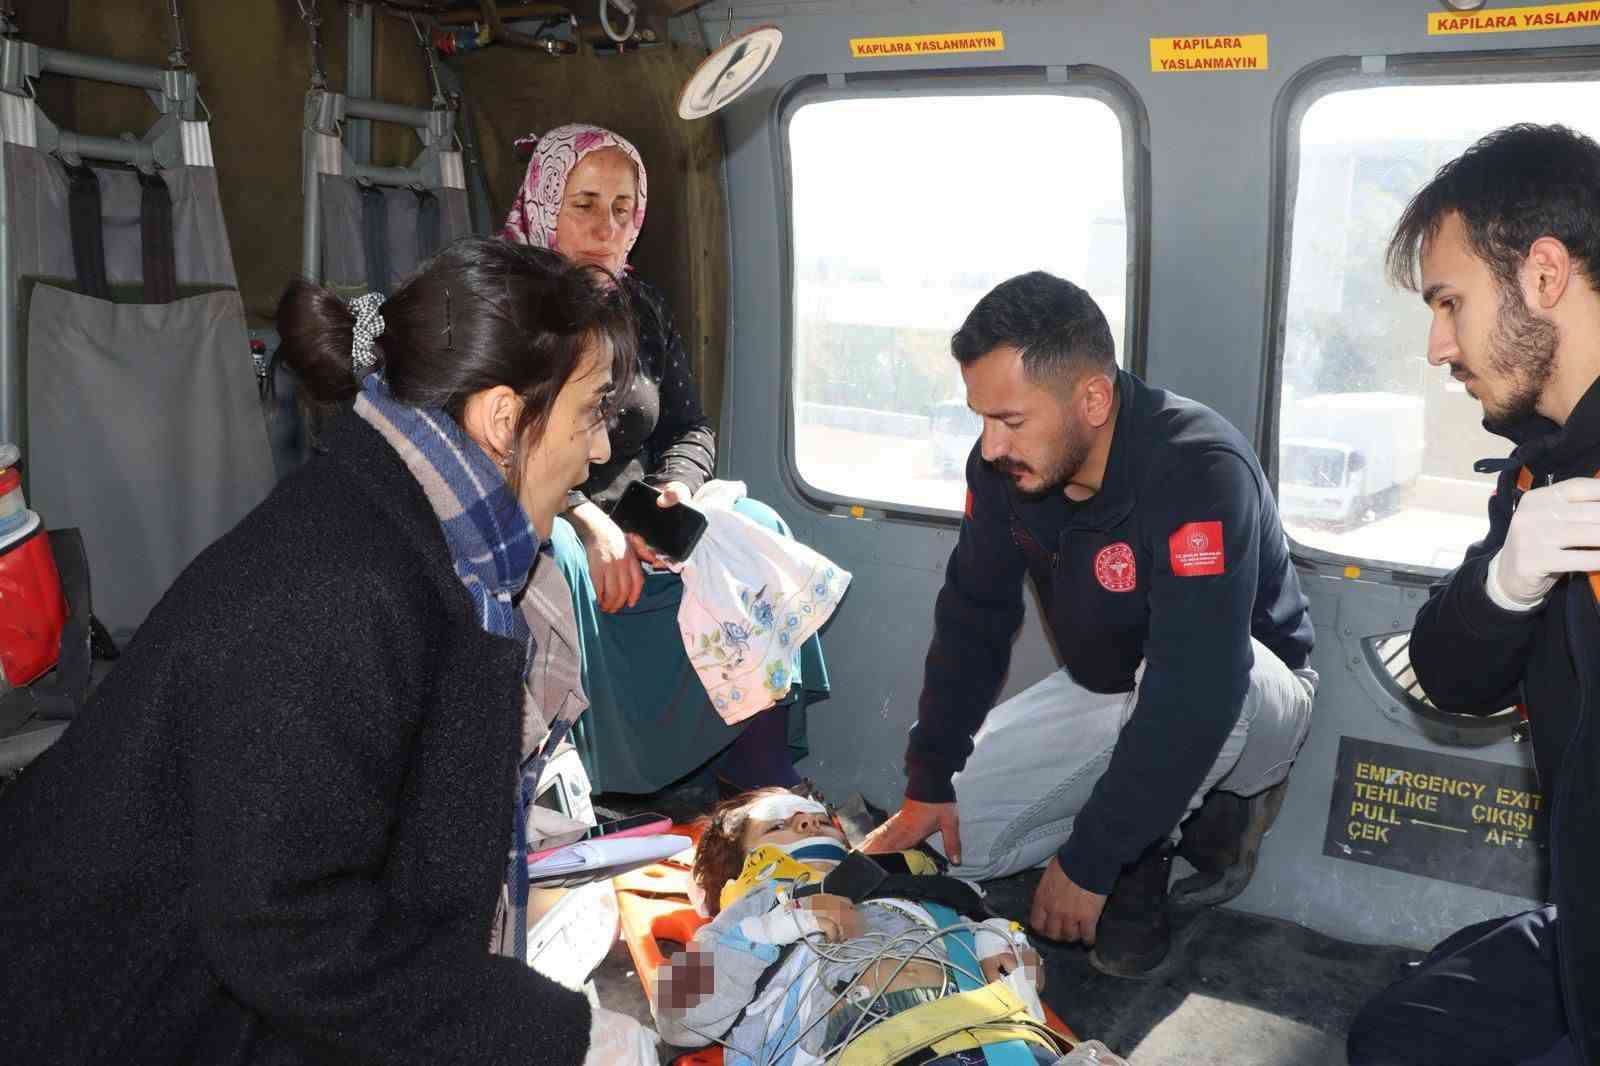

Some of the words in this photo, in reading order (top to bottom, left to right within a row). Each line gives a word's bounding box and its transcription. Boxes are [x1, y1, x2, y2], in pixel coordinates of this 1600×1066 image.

[1437, 15, 1517, 31] KAPILARA
[857, 42, 912, 55] KAPILARA
[914, 37, 996, 51] YASLANMAYIN
[1172, 38, 1242, 50] KAPILARA
[1160, 57, 1257, 70] YASLANMAYIN
[1353, 782, 1440, 812] TEHLİKE
[1471, 804, 1533, 832] ÇIKIŞI
[1495, 787, 1543, 811] EXIT
[1347, 821, 1390, 844] ÇEK
[1350, 802, 1402, 826] PULL
[1484, 828, 1529, 849] AFT
